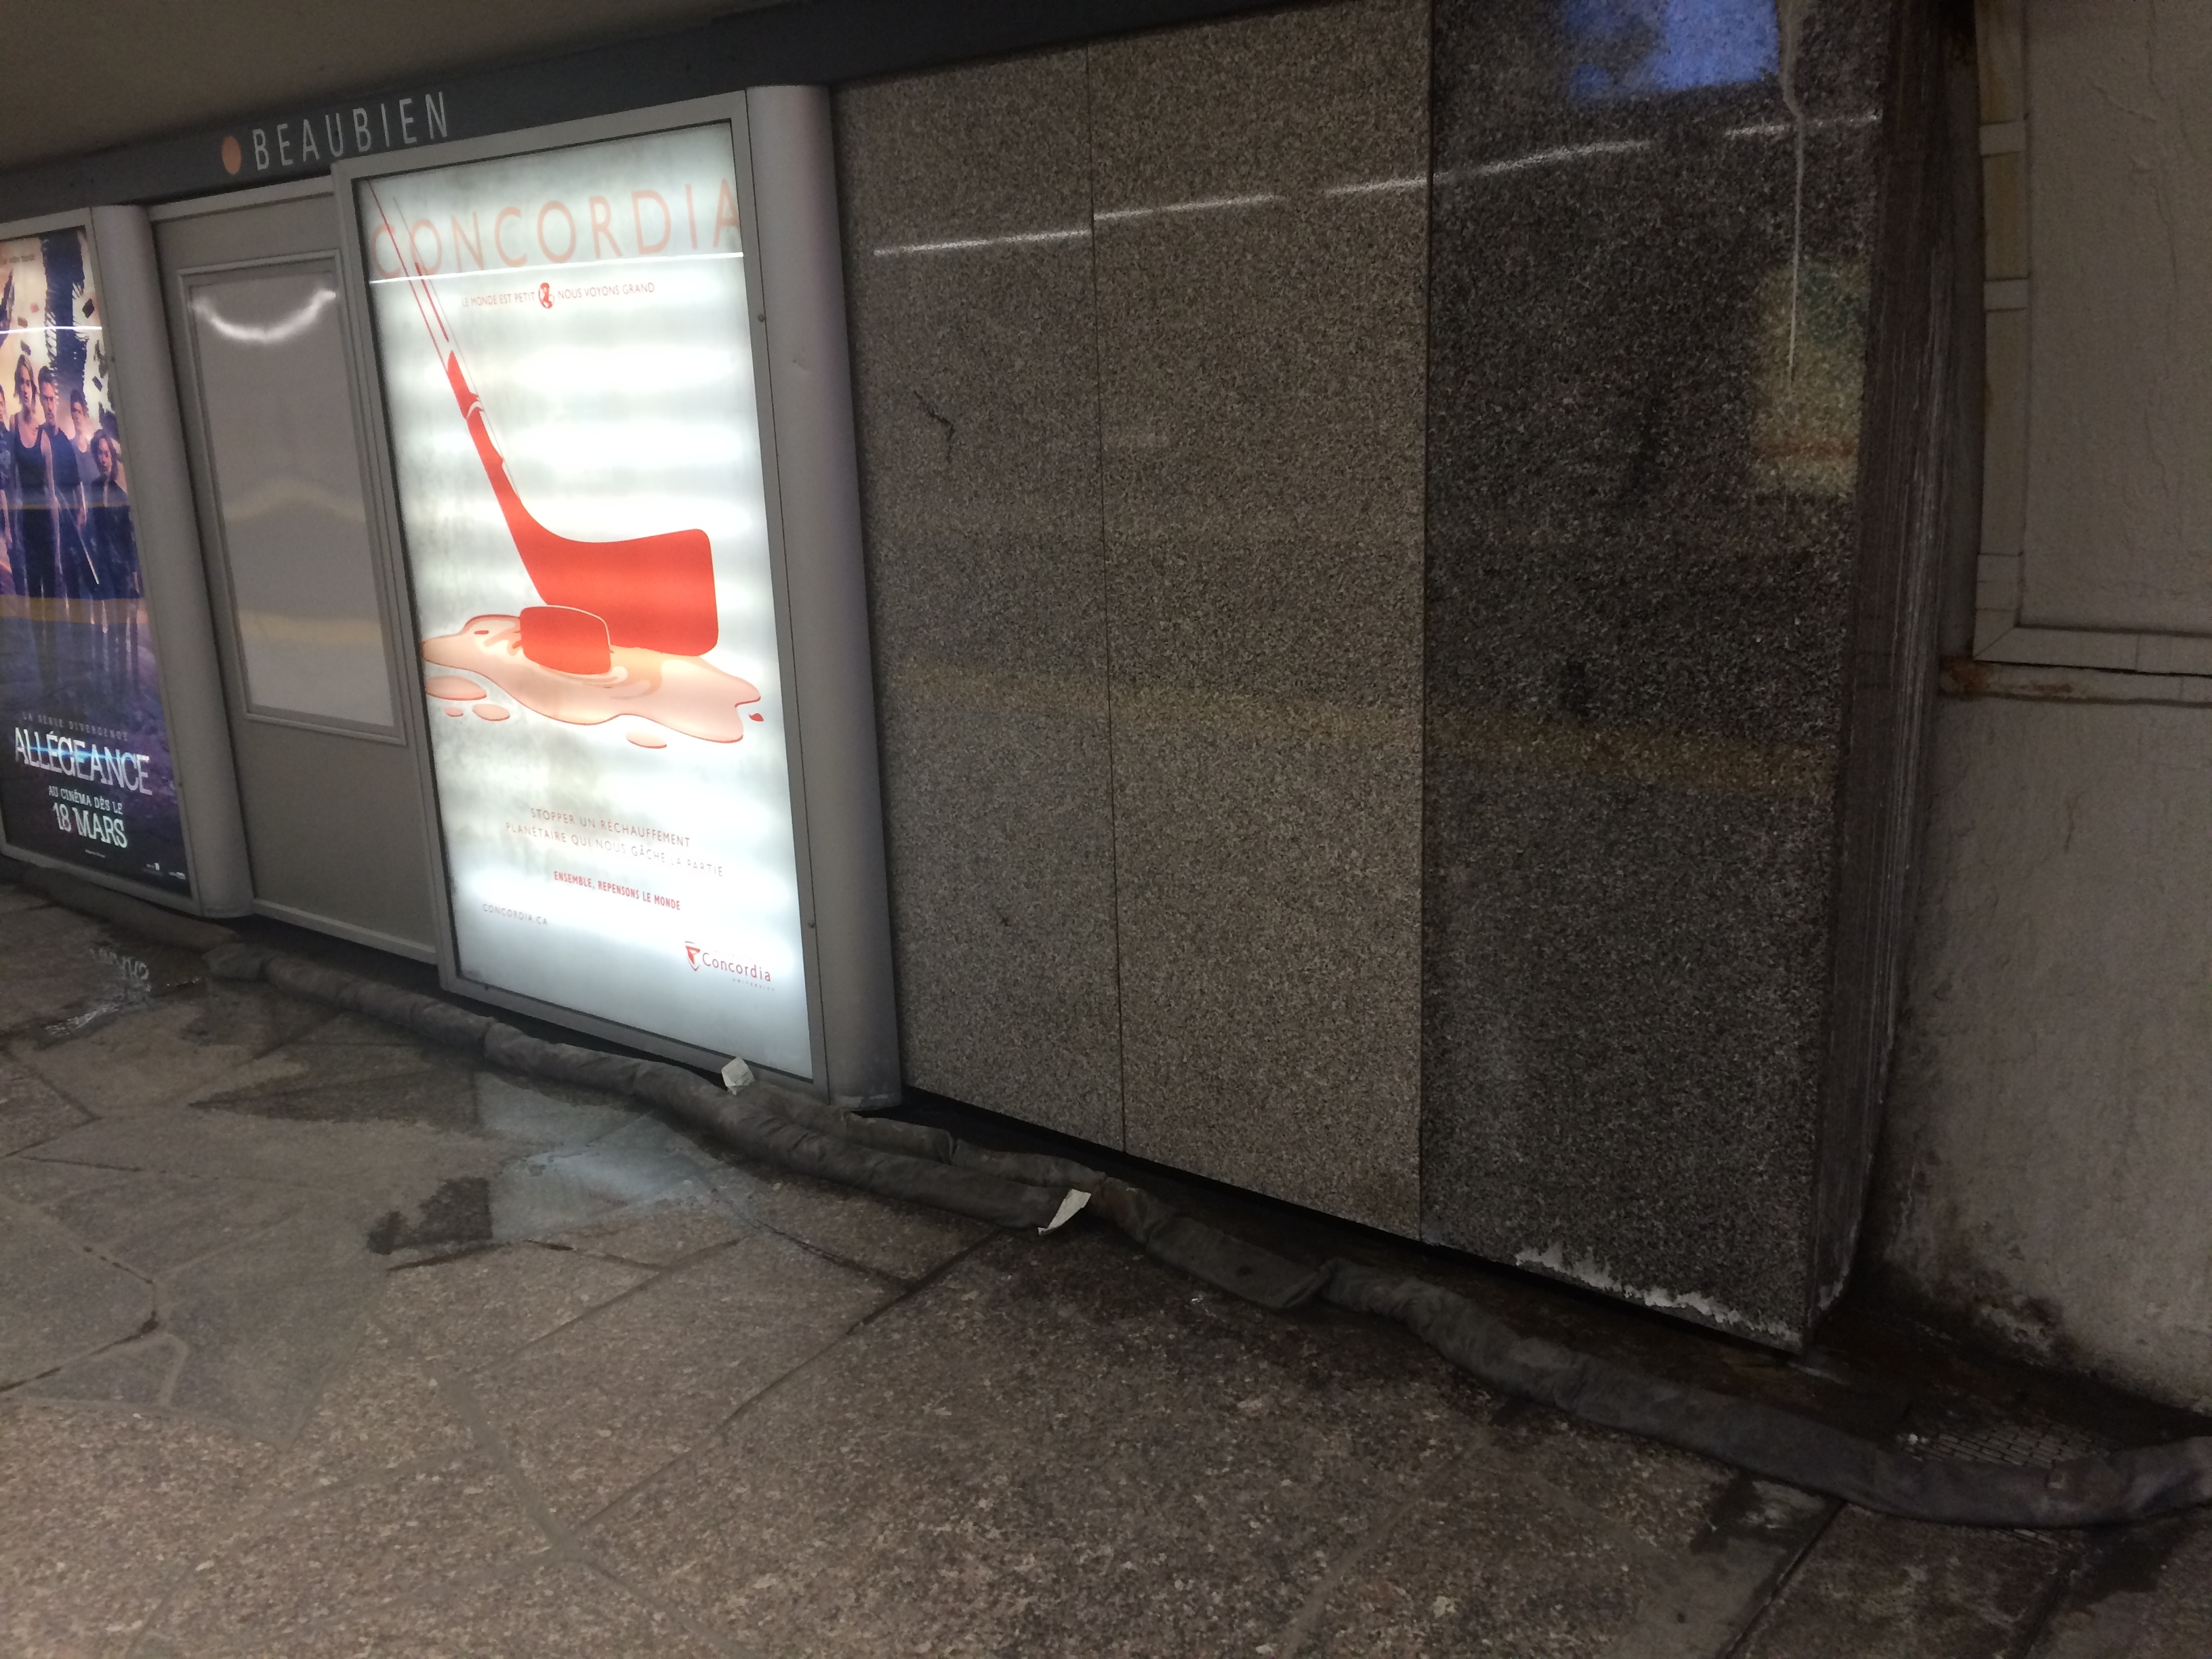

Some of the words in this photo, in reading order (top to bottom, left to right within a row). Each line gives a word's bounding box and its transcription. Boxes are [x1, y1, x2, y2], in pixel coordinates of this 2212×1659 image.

[253, 91, 448, 170] BEAUBIEN
[371, 179, 741, 279] CONCORDIA
[470, 295, 497, 306] MONDE
[499, 293, 512, 304] EST
[514, 291, 535, 303] PETIT
[558, 288, 582, 299] NOUS
[584, 285, 619, 298] VOYONS
[622, 282, 655, 295] GRAND
[15, 726, 153, 796] ALLÉGEANCE
[48, 785, 58, 798] AU
[60, 789, 92, 806] CINÉMA
[94, 795, 110, 811] DÈS
[112, 801, 123, 815] LE
[53, 802, 72, 832] 18
[72, 806, 128, 848] MARS
[531, 808, 575, 825] STOPPER
[579, 816, 596, 828] UN
[600, 819, 690, 848] RÉCHAUFFEMENT
[505, 821, 567, 843] PLANÉTAIRE
[571, 834, 591, 847] QUI
[595, 839, 626, 854] NOUS
[631, 844, 665, 863] GÂCHE
[687, 859, 723, 877] PARTIE
[554, 871, 596, 890] ENSEMBLE,
[598, 880, 640, 899] REPENSONS
[642, 891, 651, 903] LE
[654, 894, 680, 911] MONDE
[702, 952, 771, 982] Concordia
